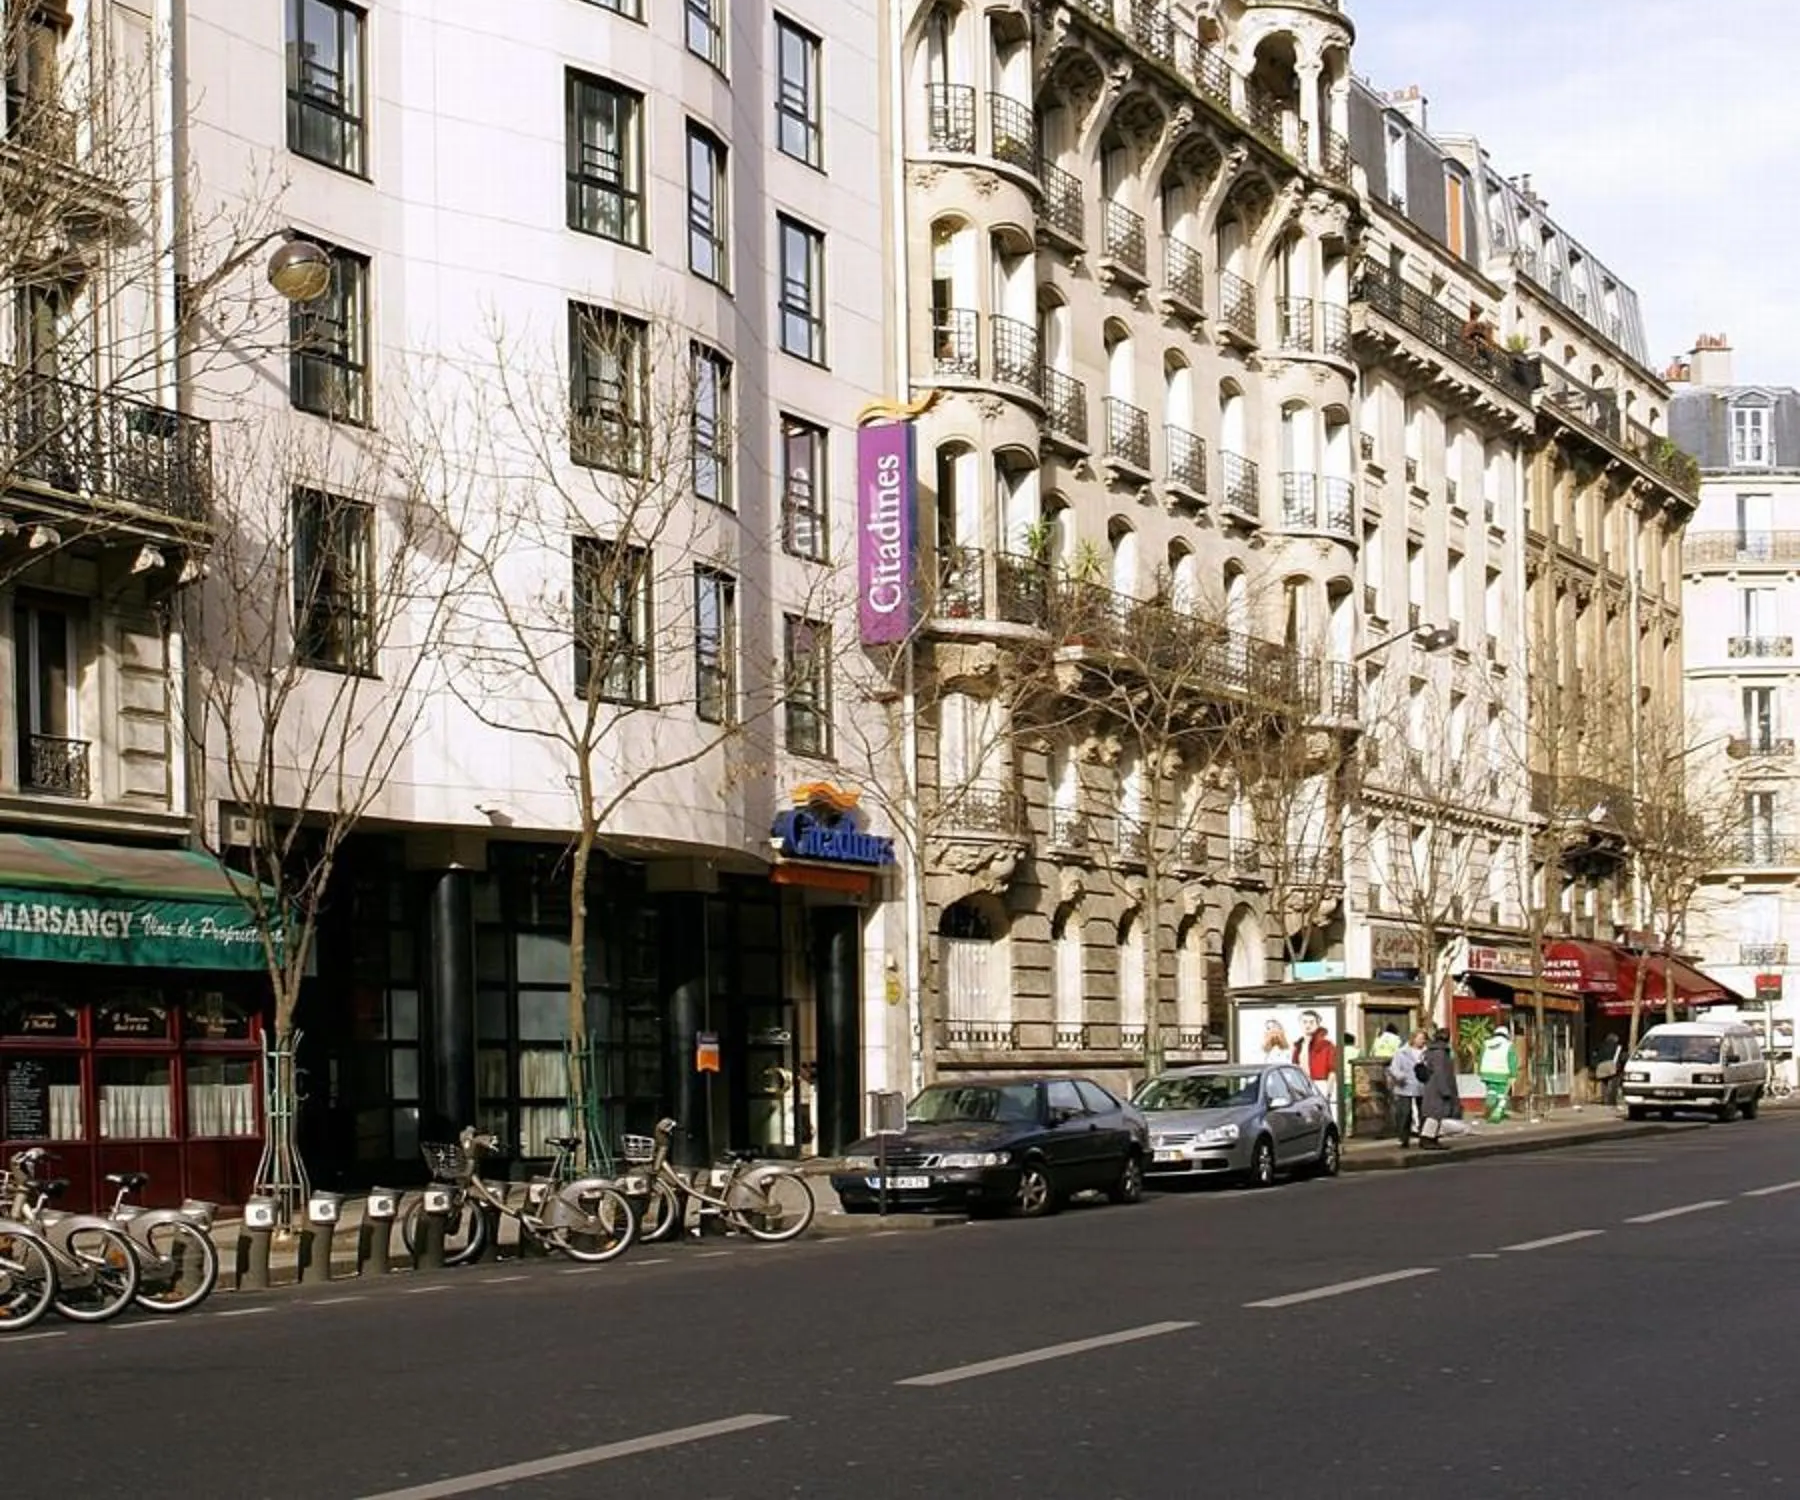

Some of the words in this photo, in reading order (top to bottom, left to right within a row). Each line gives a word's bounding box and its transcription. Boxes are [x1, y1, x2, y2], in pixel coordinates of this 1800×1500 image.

[867, 453, 902, 613] Citadines
[784, 806, 896, 865] Citadines
[140, 914, 171, 937] Vins
[178, 917, 194, 938] de
